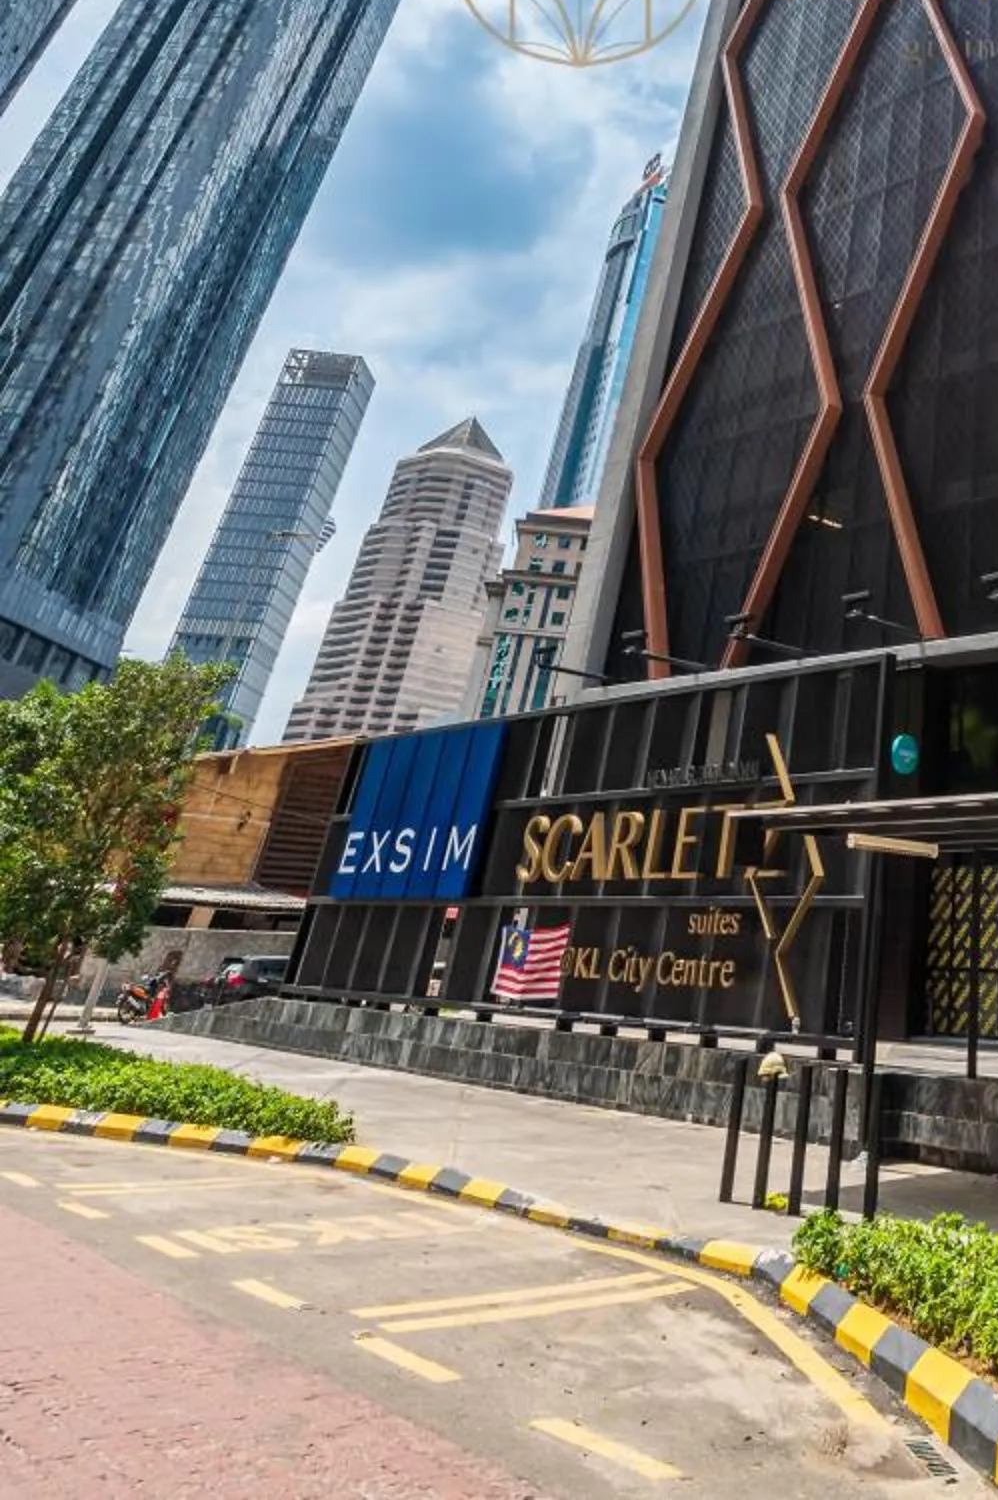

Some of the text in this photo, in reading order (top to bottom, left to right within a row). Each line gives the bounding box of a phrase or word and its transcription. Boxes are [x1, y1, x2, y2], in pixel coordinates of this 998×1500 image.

[337, 823, 478, 874] EXSIM
[687, 905, 742, 935] suites
[607, 946, 654, 992] City
[655, 950, 736, 988] Centre
